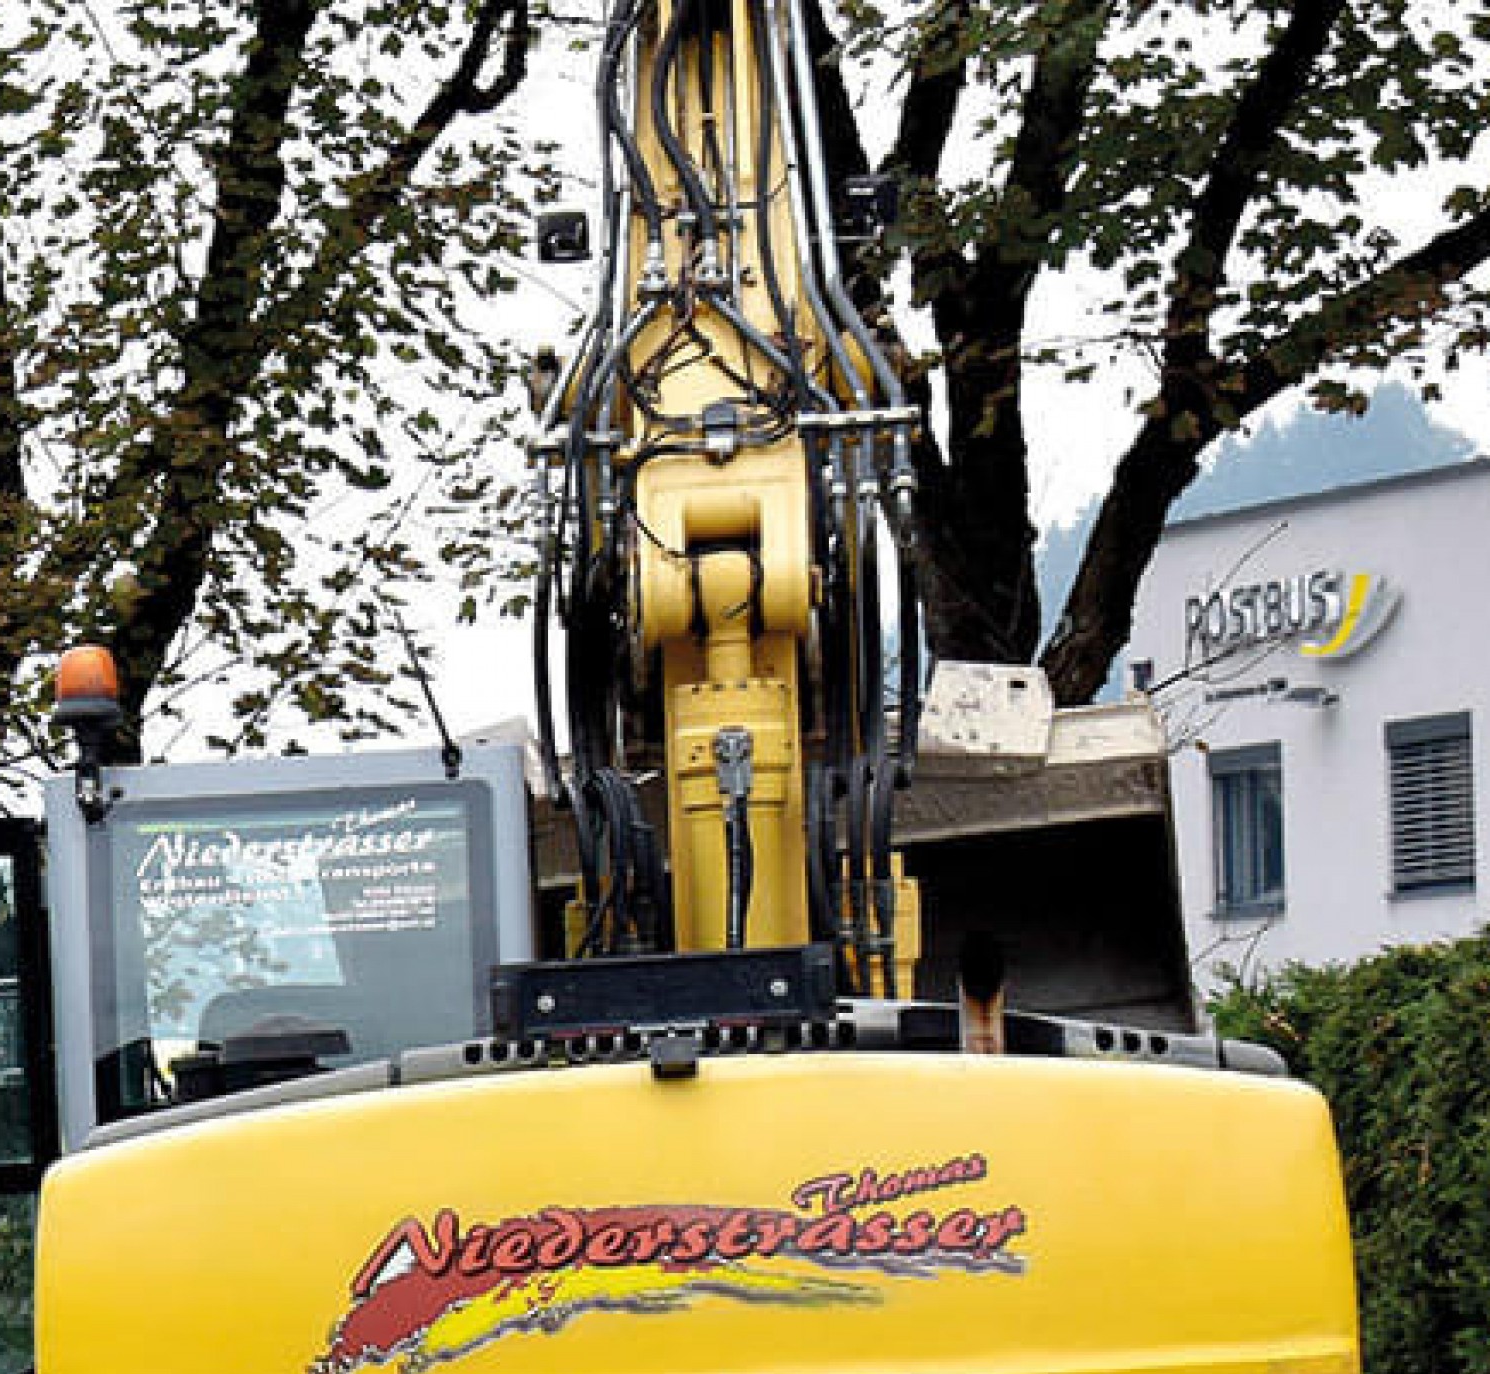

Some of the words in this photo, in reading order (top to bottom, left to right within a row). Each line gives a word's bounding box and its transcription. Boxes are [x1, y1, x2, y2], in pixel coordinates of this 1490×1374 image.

[1184, 571, 1344, 650] POSTBUS
[792, 1152, 988, 1218] Thomas
[351, 1203, 1026, 1300] Niederstrasser
